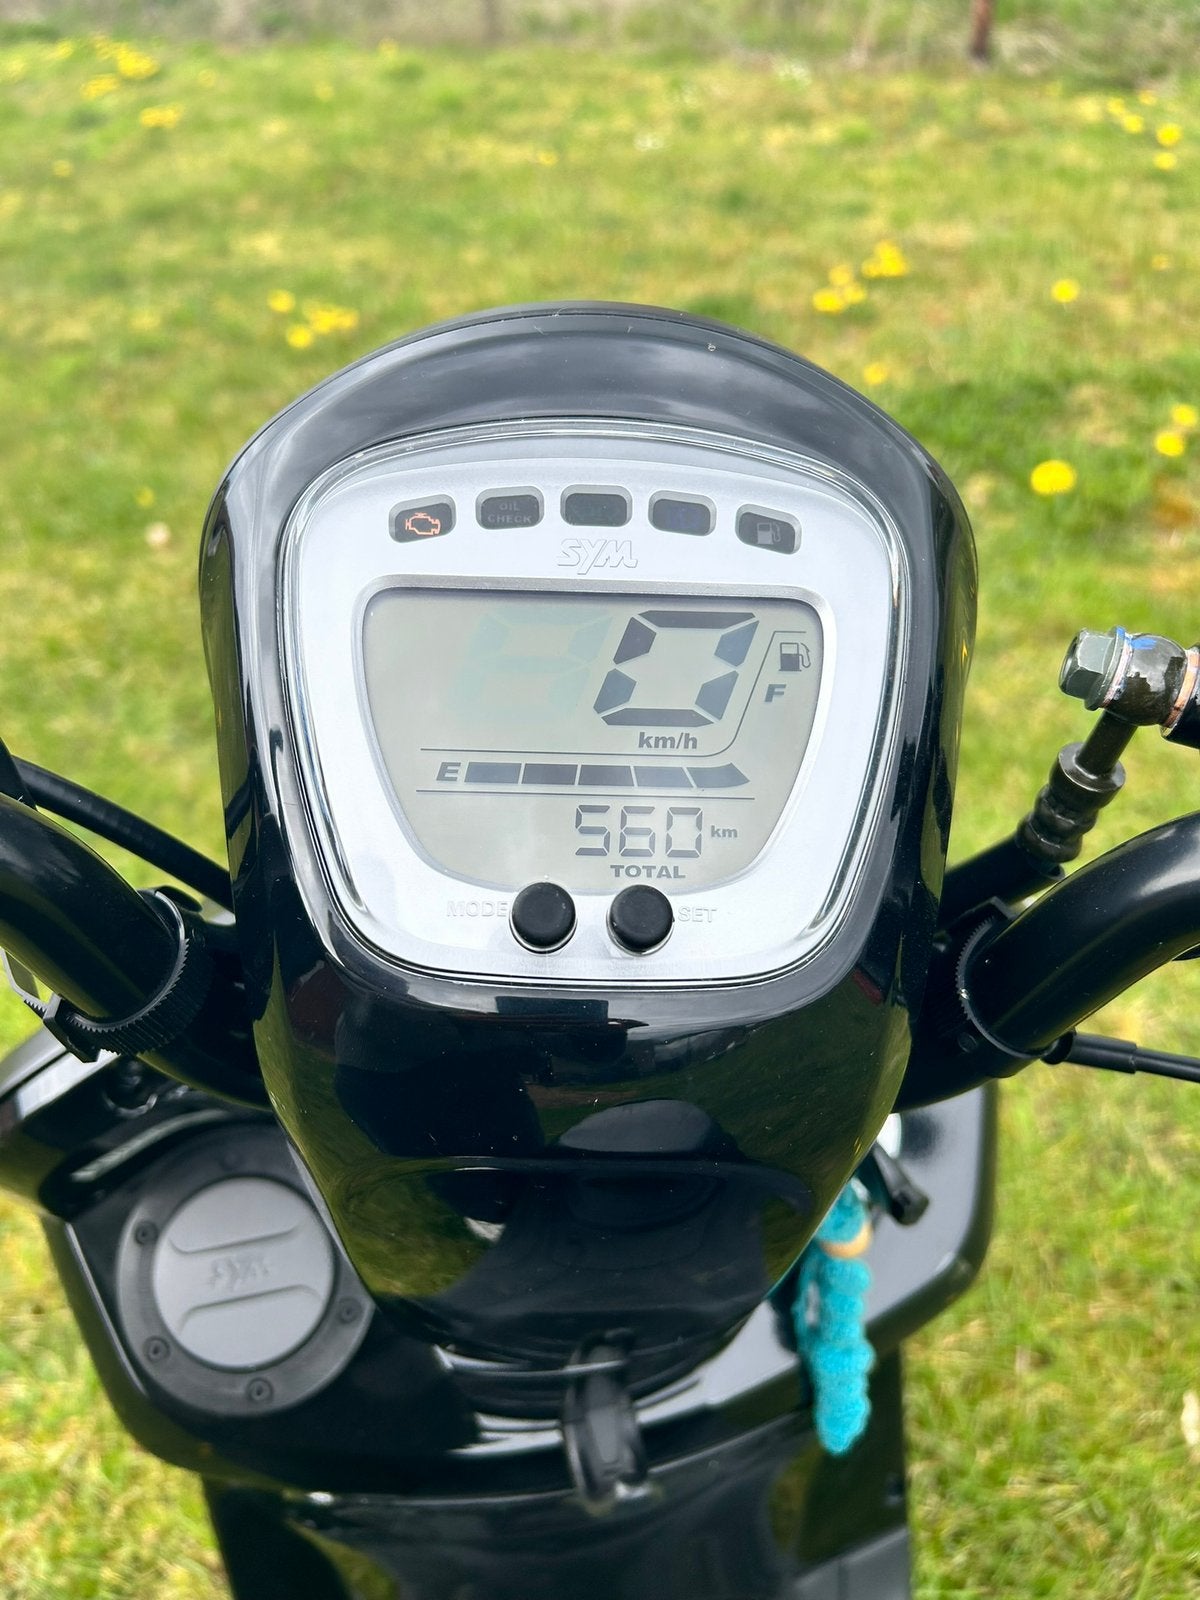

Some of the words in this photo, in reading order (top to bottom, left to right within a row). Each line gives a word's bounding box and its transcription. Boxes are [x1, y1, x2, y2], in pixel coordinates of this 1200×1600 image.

[499, 502, 520, 511] OIL
[487, 513, 532, 524] CHECK
[556, 538, 638, 575] SYM
[593, 610, 760, 727] 0
[764, 684, 786, 703] F
[638, 732, 698, 750] km/h
[437, 763, 461, 782] E
[575, 805, 703, 858] 560
[710, 824, 738, 839] km
[610, 865, 686, 879] TOTAL
[446, 901, 508, 918] MODE
[678, 906, 717, 923] SET
